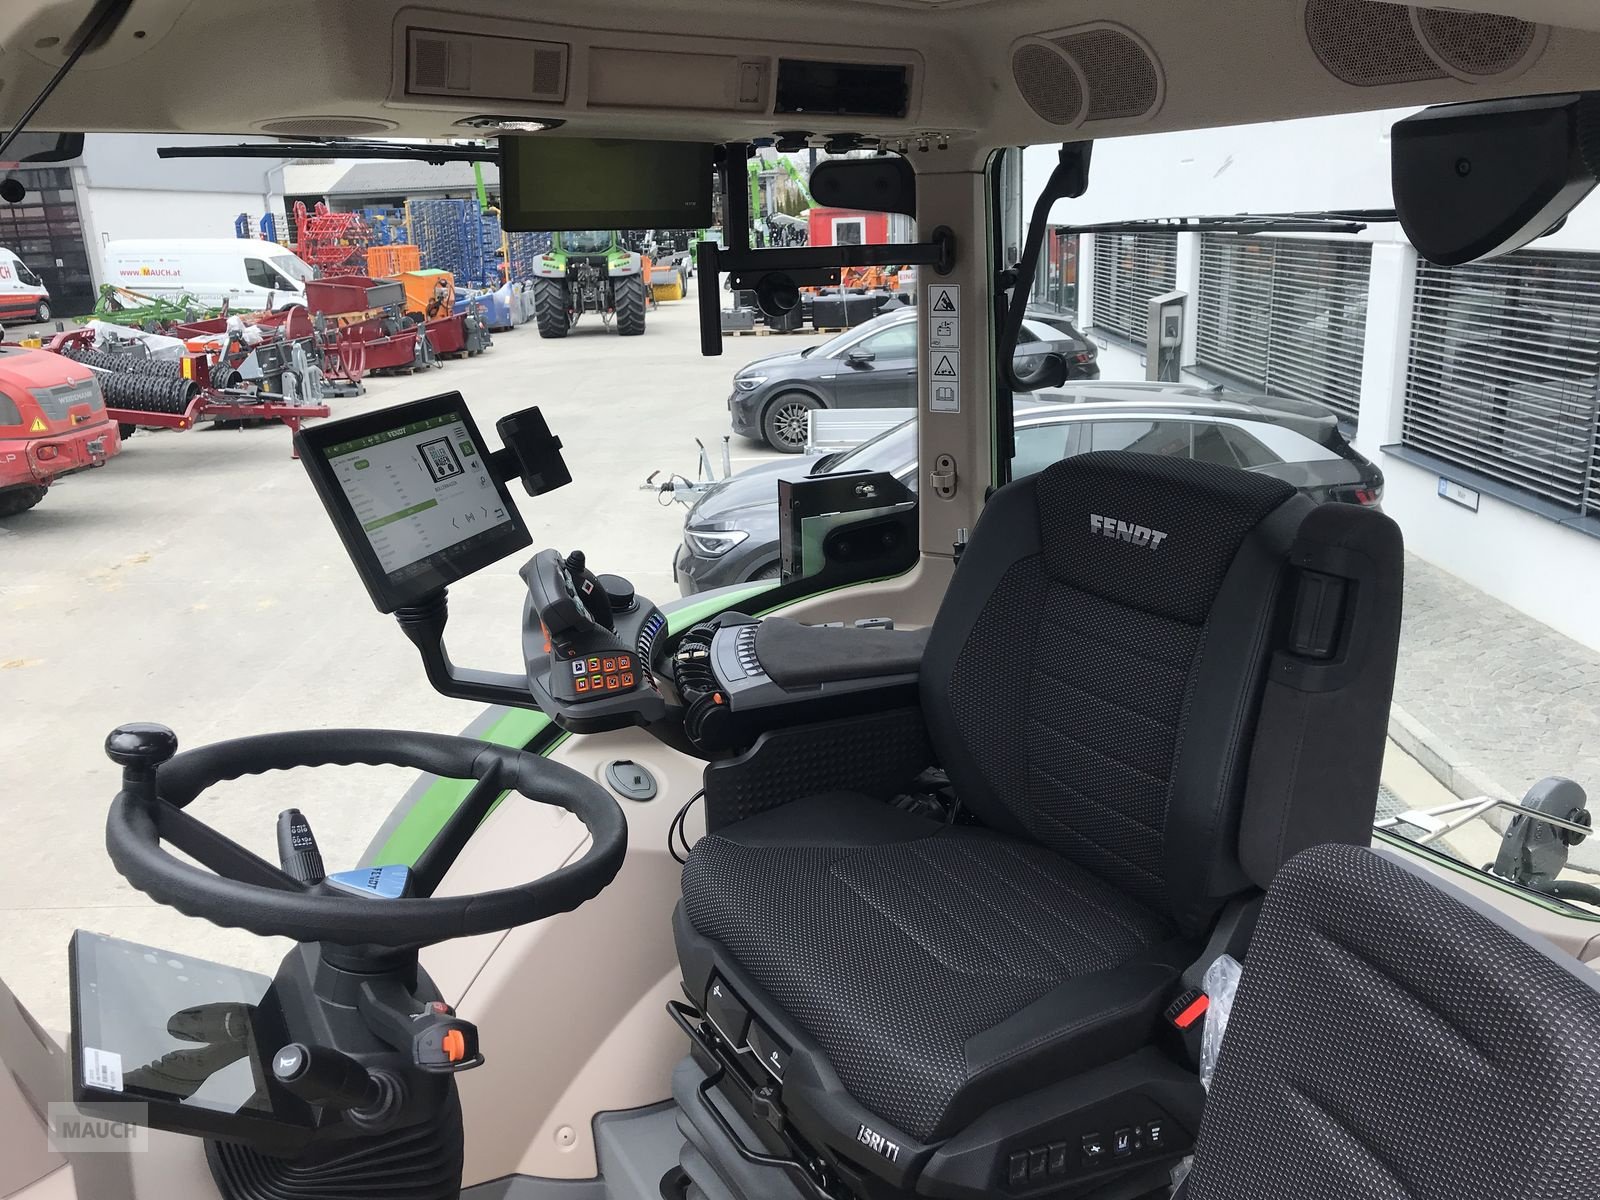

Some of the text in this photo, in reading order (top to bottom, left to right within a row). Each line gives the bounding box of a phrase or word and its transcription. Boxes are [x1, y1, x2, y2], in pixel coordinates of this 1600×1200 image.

[119, 268, 181, 277] www.MAUCH.at
[1090, 513, 1168, 551] FENDT
[367, 867, 384, 890] FENDT
[857, 1124, 886, 1154] ISRI
